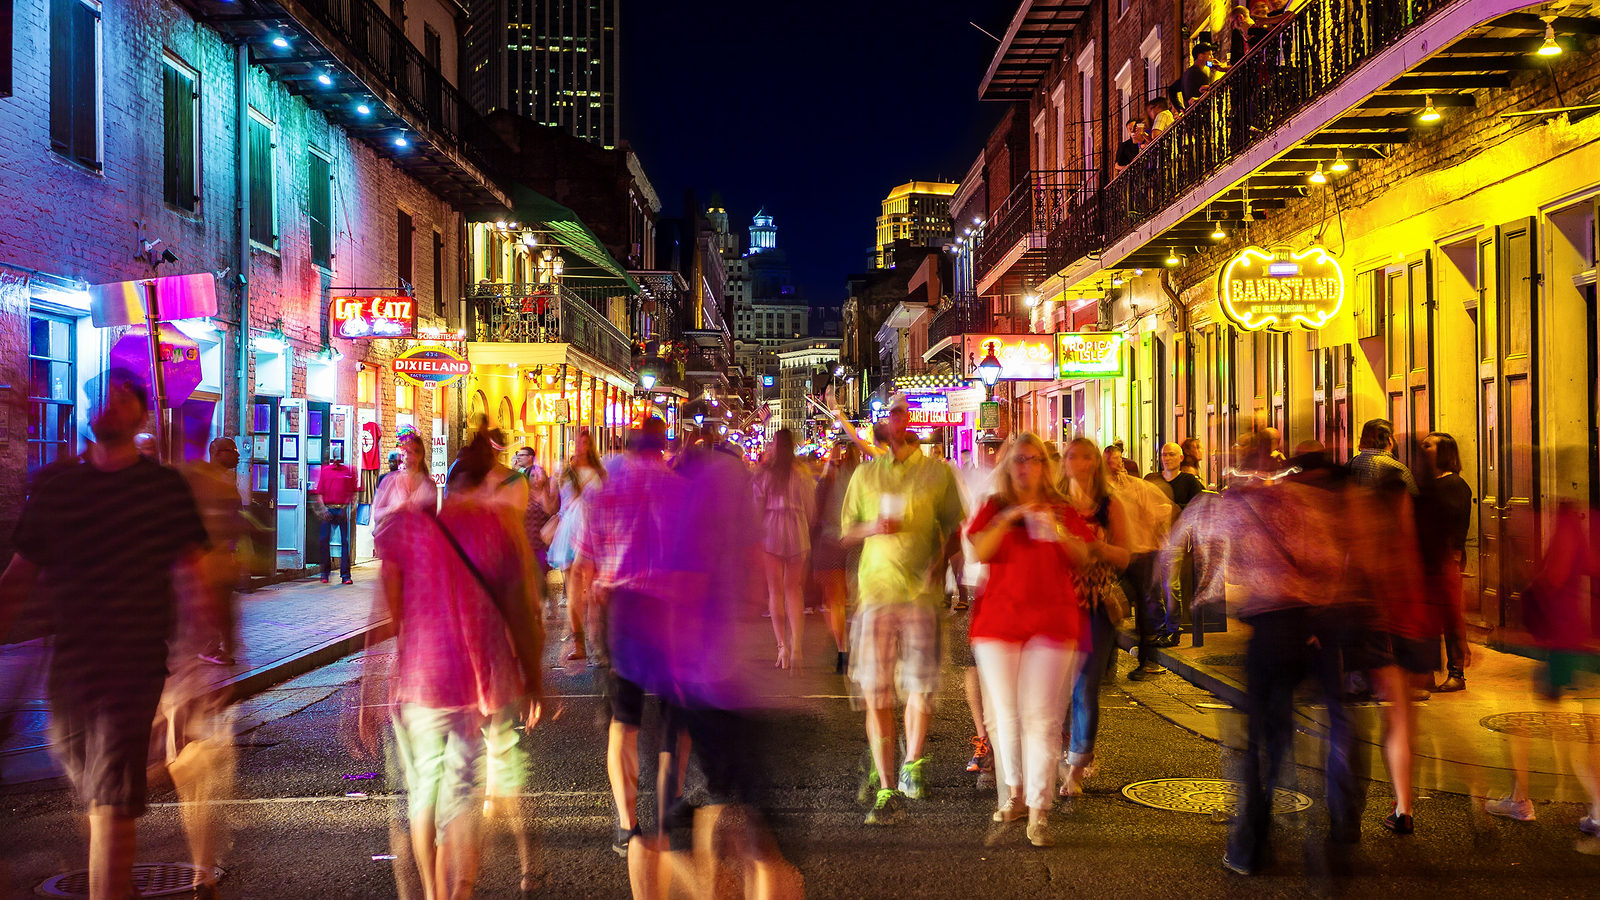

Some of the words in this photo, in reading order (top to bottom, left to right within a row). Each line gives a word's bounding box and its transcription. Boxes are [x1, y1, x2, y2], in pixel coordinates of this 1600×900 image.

[1232, 277, 1338, 302] BANDSTAND
[372, 297, 411, 319] CATZ
[1079, 350, 1103, 361] ISLE
[395, 360, 468, 372] DIXIELAND
[930, 410, 947, 422] LEGAL
[948, 411, 963, 422] CLUB
